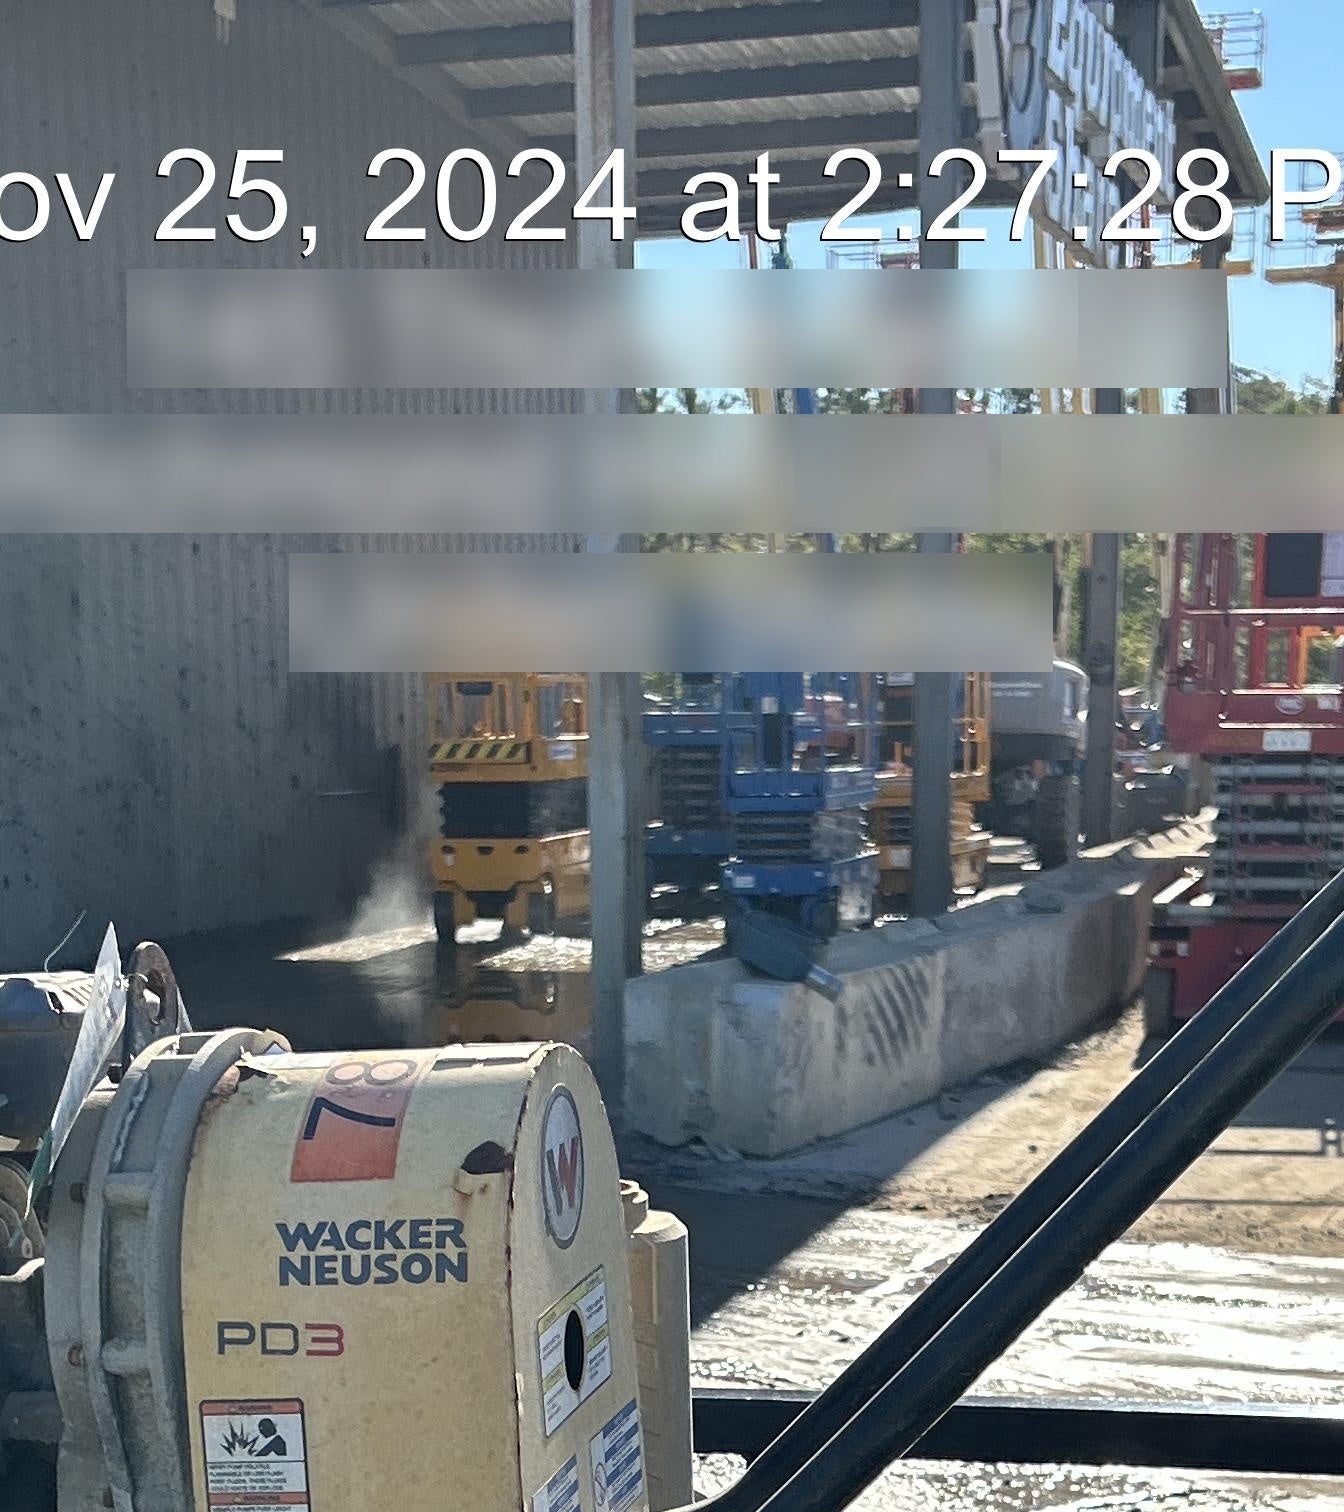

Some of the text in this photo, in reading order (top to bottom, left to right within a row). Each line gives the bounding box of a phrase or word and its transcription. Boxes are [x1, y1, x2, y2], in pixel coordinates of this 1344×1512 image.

[275, 1218, 467, 1252] WACKER
[278, 1252, 468, 1287] NEUSON
[216, 1320, 345, 1358] PD3
